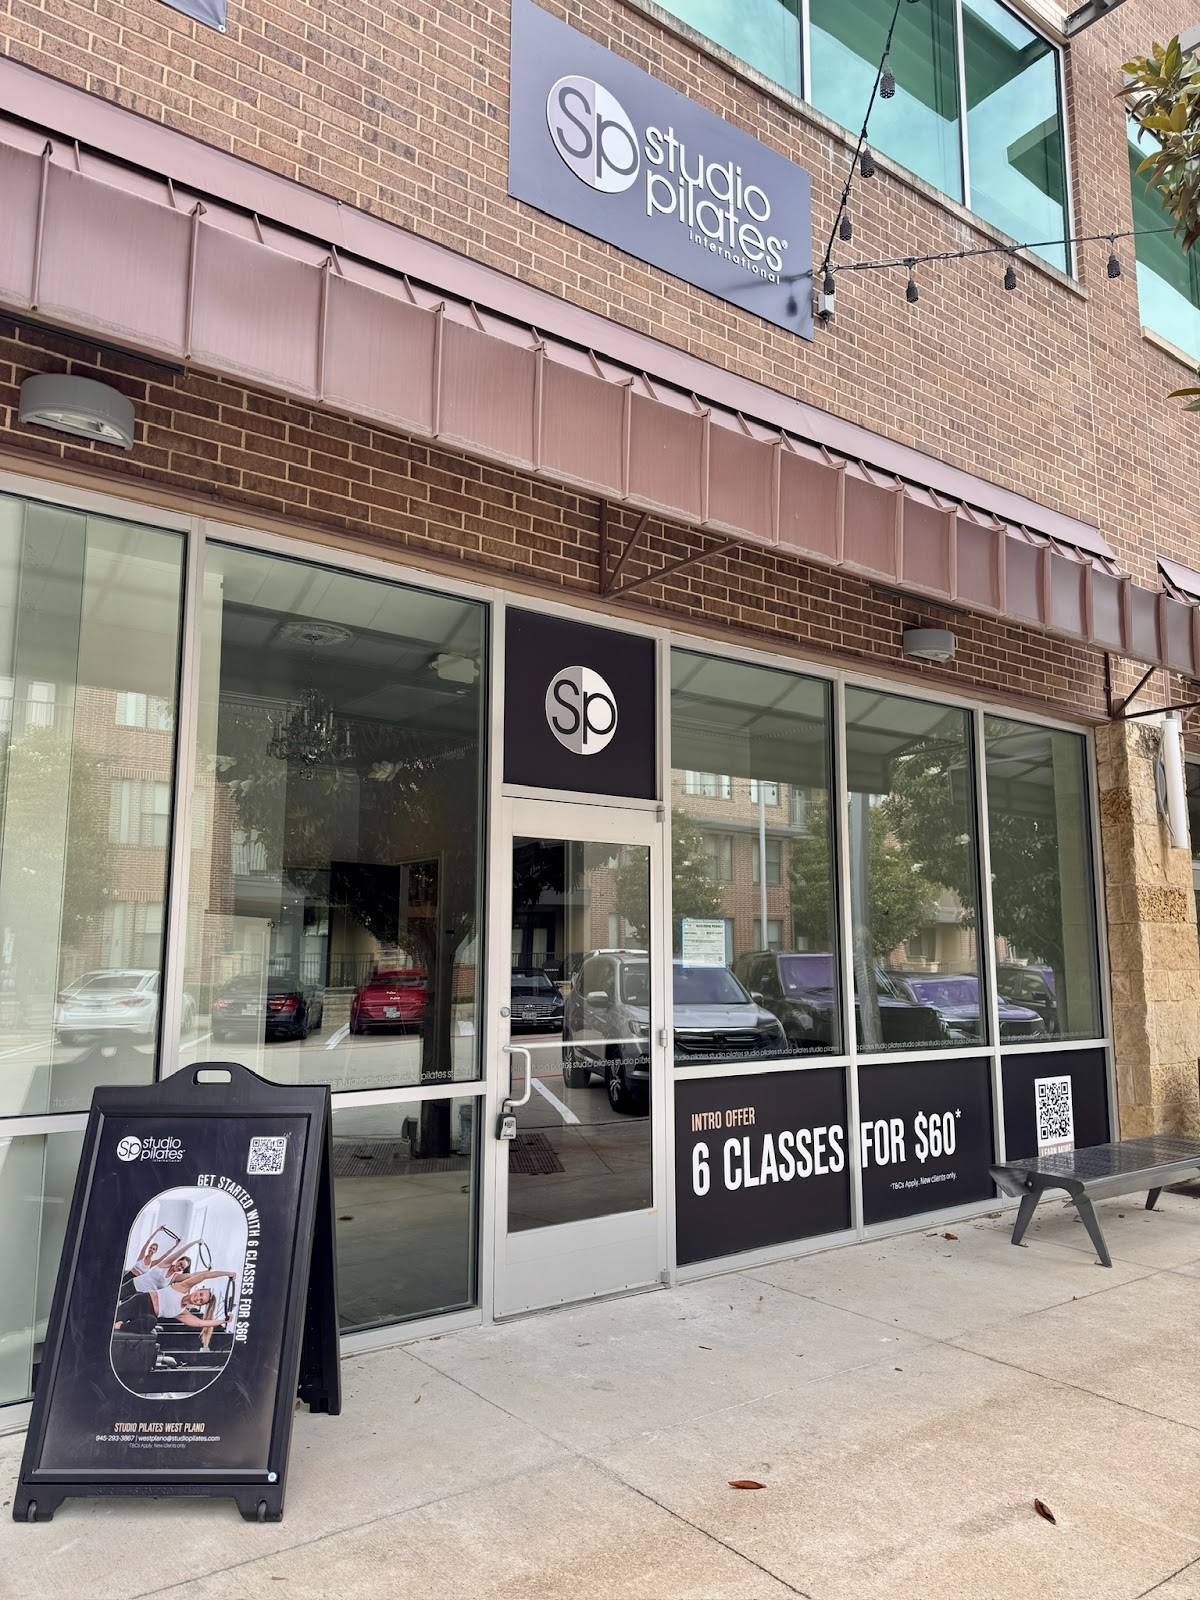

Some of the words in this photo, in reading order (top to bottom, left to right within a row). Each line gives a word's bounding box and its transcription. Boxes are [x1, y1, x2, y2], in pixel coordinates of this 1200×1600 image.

[645, 126, 771, 222] studio
[689, 230, 780, 285] international
[421, 1069, 446, 1082] pilates
[691, 1110, 721, 1132] INTRO
[725, 1107, 755, 1128] OFFER
[142, 1136, 182, 1149] studio
[692, 1141, 710, 1196] 6
[723, 1124, 844, 1190] CLASSES
[861, 1118, 906, 1168] FOR
[197, 1174, 216, 1187] GET
[218, 1176, 254, 1209] STARTED
[246, 1208, 260, 1237] WITH
[247, 1240, 260, 1248] 6
[241, 1250, 258, 1295] CLASSES
[238, 1299, 252, 1319] FOR
[114, 1422, 138, 1433] STUDIO
[138, 1422, 164, 1433] PILATES
[165, 1422, 183, 1433] WEST
[184, 1422, 205, 1433] PLANO
